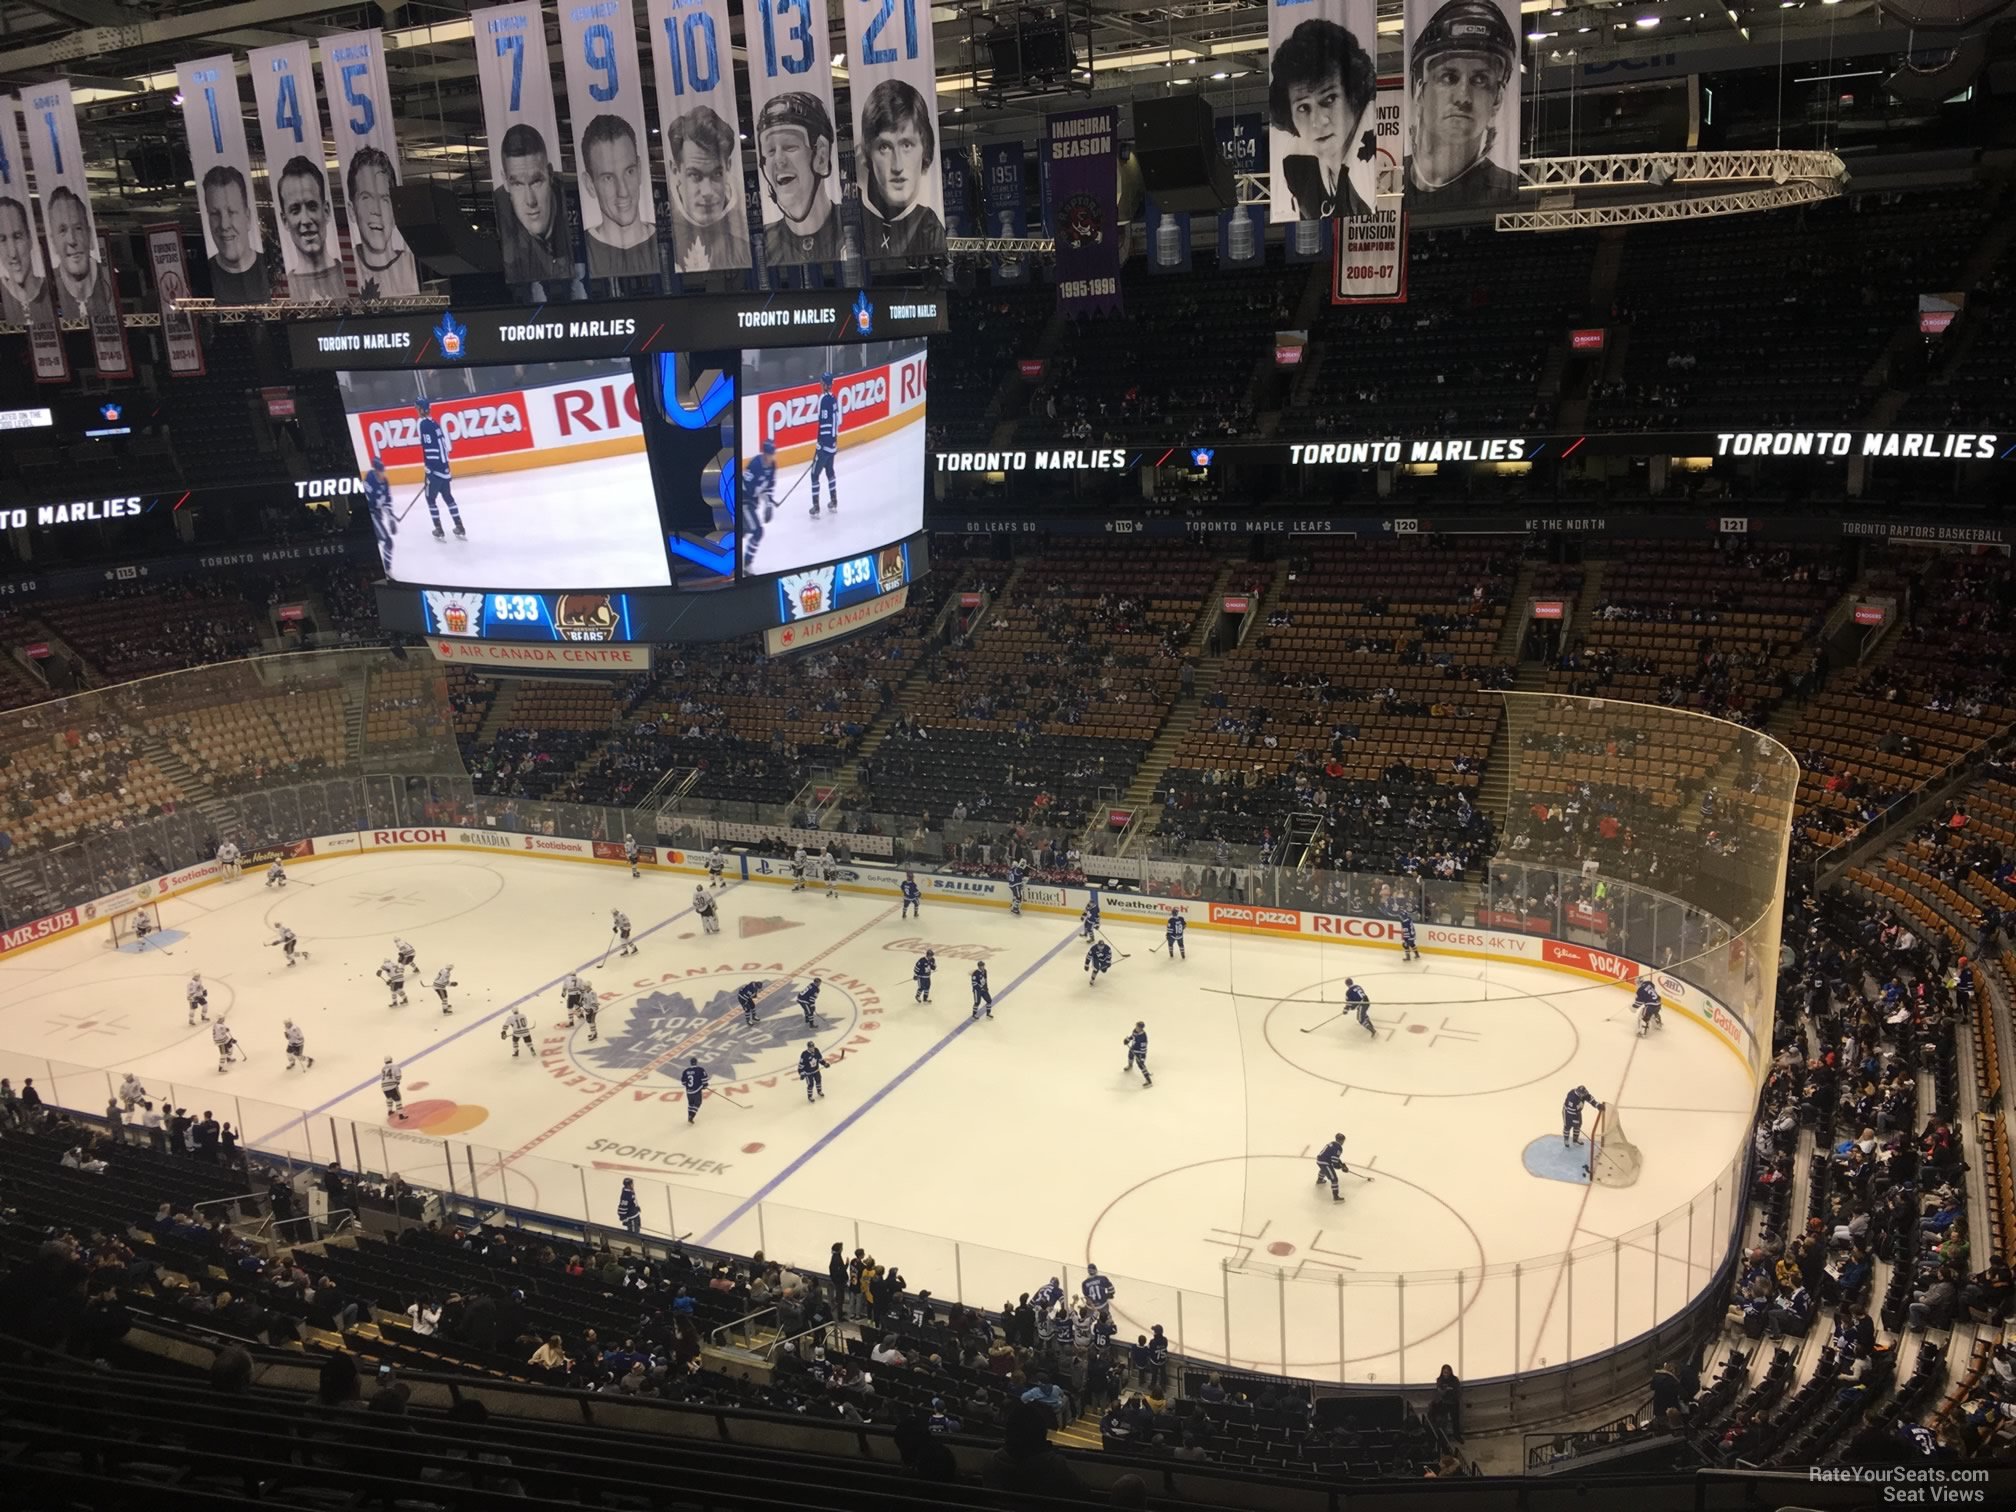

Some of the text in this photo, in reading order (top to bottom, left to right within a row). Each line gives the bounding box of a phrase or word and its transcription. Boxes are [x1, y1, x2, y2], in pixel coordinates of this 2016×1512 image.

[760, 0, 814, 77] 13
[861, 0, 918, 65] 21
[584, 24, 619, 102] 9
[664, 10, 720, 96] 10
[495, 35, 524, 111] 7
[276, 74, 303, 143] 4
[341, 63, 375, 135] 5
[205, 87, 223, 153] 1
[1052, 115, 1111, 138] INAUGURAL
[45, 112, 63, 174] 1
[1052, 136, 1111, 159] SEASON
[1222, 138, 1255, 159] 1964
[992, 165, 1017, 184] 1951
[844, 183, 859, 199] 48
[657, 201, 671, 217] 42
[1350, 210, 1396, 224] ATLANTIC
[1349, 225, 1396, 240] DIVISION
[1348, 241, 1395, 252] CHAMPIONS
[1347, 265, 1394, 279] 2006-07
[737, 308, 836, 328] TORONTO MARLIES
[889, 305, 915, 319] TORONTO
[499, 318, 636, 342] TORONTO MARLIES
[1580, 334, 1601, 343] ROGERS
[317, 332, 411, 352] TORONTO MARLIES
[837, 376, 886, 426] pizza
[441, 403, 522, 452] pizza
[1290, 438, 1525, 465] TORONTO MARLIES
[1717, 433, 1998, 458] TORONTO MARLIES
[936, 449, 1126, 471] TORONTO MARLIES
[38, 496, 141, 526] MARLIES
[967, 522, 1036, 532] GO LEAFS GO
[1117, 521, 1132, 531] 119
[1186, 522, 1331, 532] TORONTO MAPLE LEAFS
[1396, 520, 1416, 531] 120
[1525, 519, 1605, 530] WE THE NORTH
[1723, 520, 1744, 530] 121
[1843, 522, 2003, 542] TORONTO RAPTORS BASKETBALL
[200, 544, 345, 568] TORONTO MAPLE LEAFS
[119, 567, 135, 579] 115
[21, 581, 36, 593] GO
[494, 595, 539, 621] 9:33
[802, 622, 823, 638] AIR
[829, 607, 871, 630] CANADA
[570, 631, 604, 641] BEARS
[460, 645, 633, 663] AIR CANADA CENTRE
[374, 830, 447, 845] RICOH
[471, 834, 511, 848] CANADIAN
[536, 840, 582, 852] Scotiabank
[172, 864, 222, 885] Scotiaban
[934, 879, 995, 893] SAILUN
[1028, 888, 1060, 902] intact
[1106, 897, 1188, 913] WeatherTech
[1213, 906, 1297, 926] pizza pizza
[2, 910, 74, 950] MR.SUB
[1175, 923, 1183, 934] 18
[1313, 916, 1403, 940] RICOH
[1428, 930, 1526, 951] ROGERS 4K TV
[633, 963, 883, 1015] CANADA CENTRE
[1664, 979, 1681, 993] AHL
[516, 1016, 527, 1029] 10
[1714, 1008, 1742, 1043] Castrol
[648, 1029, 738, 1052] MALE
[687, 1075, 694, 1088] 3
[586, 1138, 733, 1176] SPORTCHEK
[1089, 1285, 1102, 1301] 41
[1096, 1335, 1106, 1346] 16
[1155, 1349, 1167, 1361] 75
